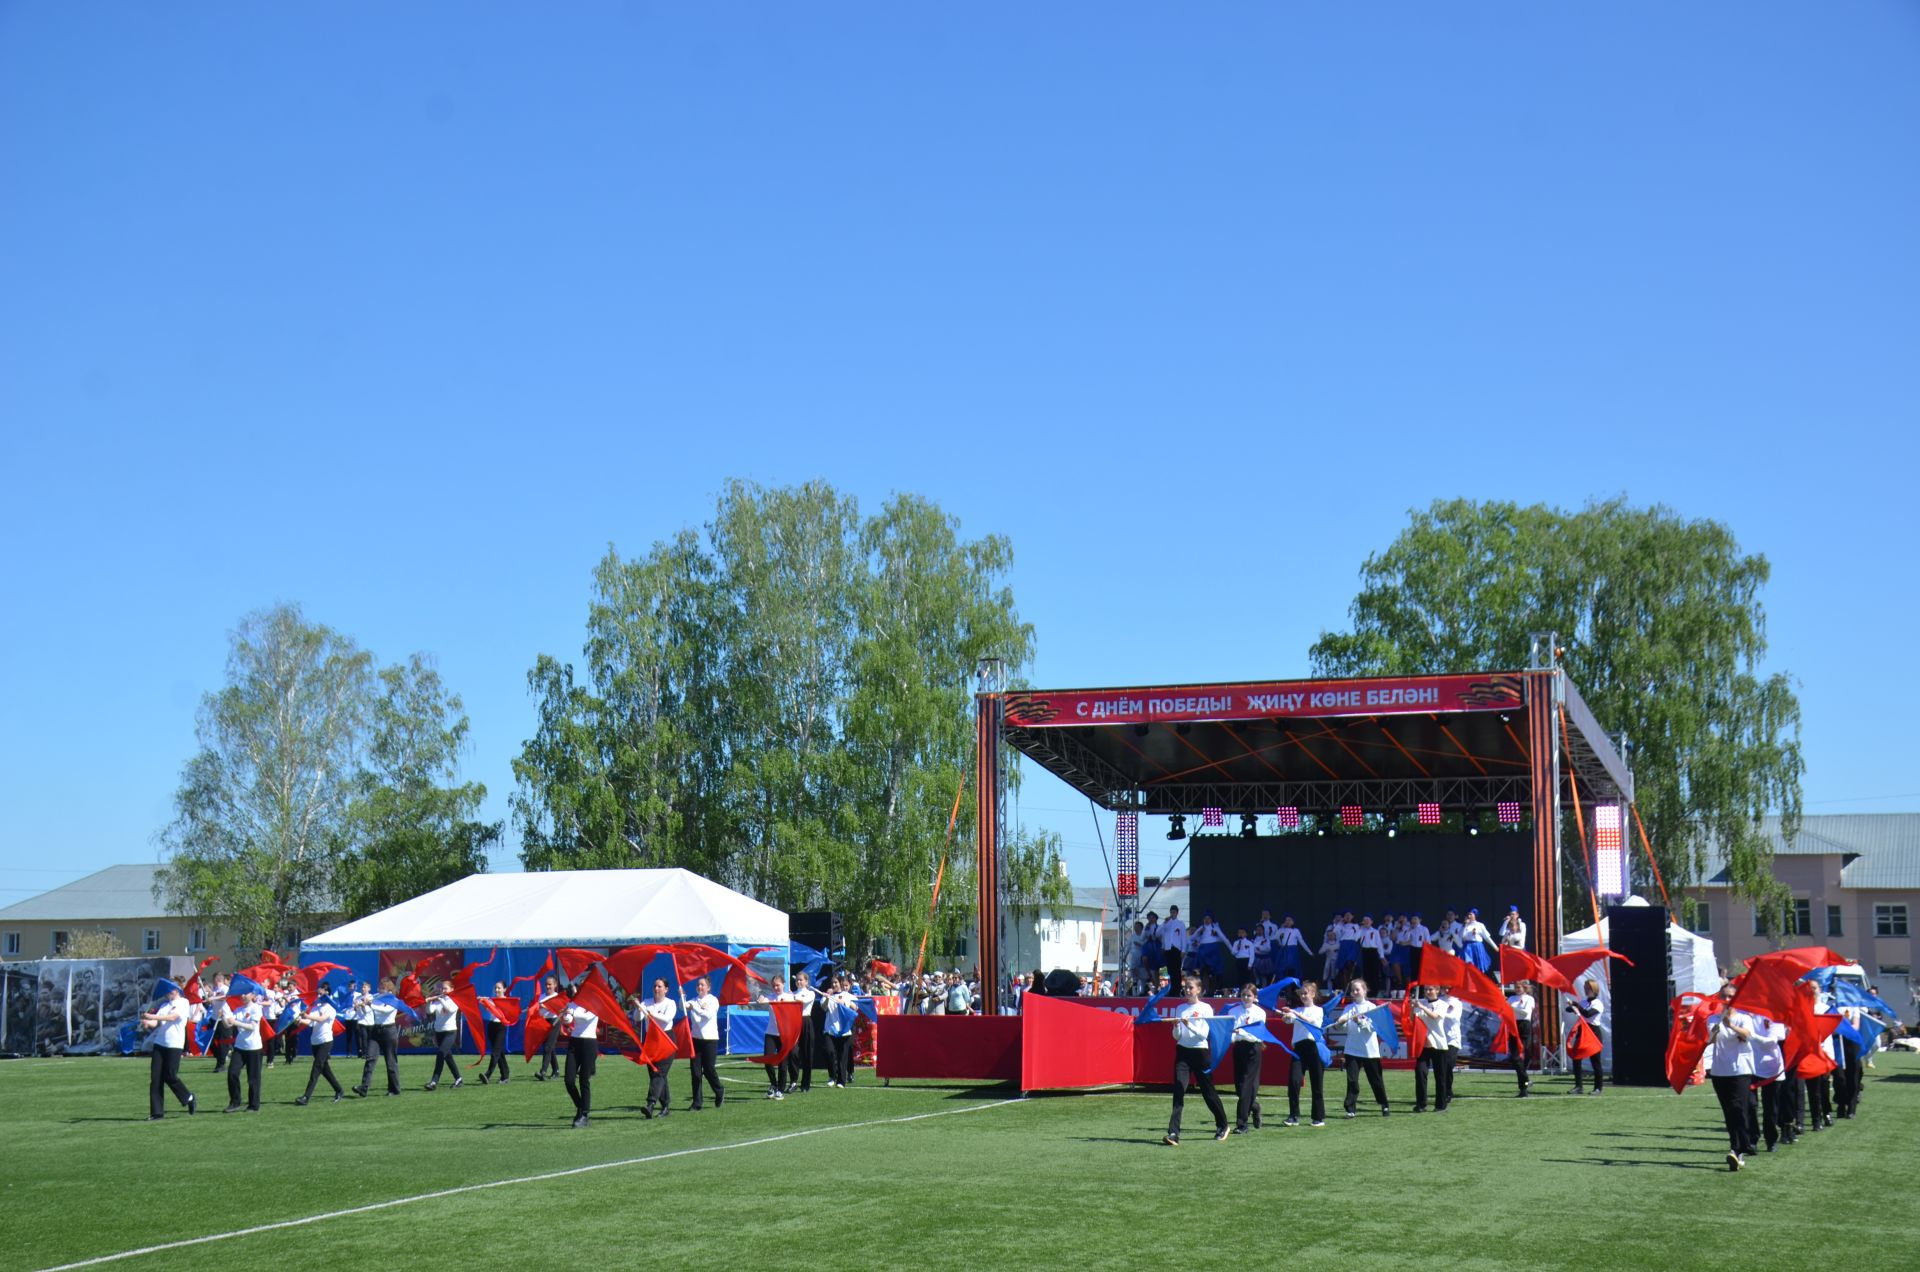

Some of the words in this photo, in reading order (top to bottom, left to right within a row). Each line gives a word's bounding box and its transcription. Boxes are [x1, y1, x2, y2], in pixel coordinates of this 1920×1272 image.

[1076, 701, 1088, 717] С
[1091, 697, 1143, 719] ДНЁМ
[1148, 695, 1232, 715] ПОБЕДЫ!
[1310, 690, 1361, 708] КӨНЕ
[1366, 687, 1439, 706] БЕЛӘН!
